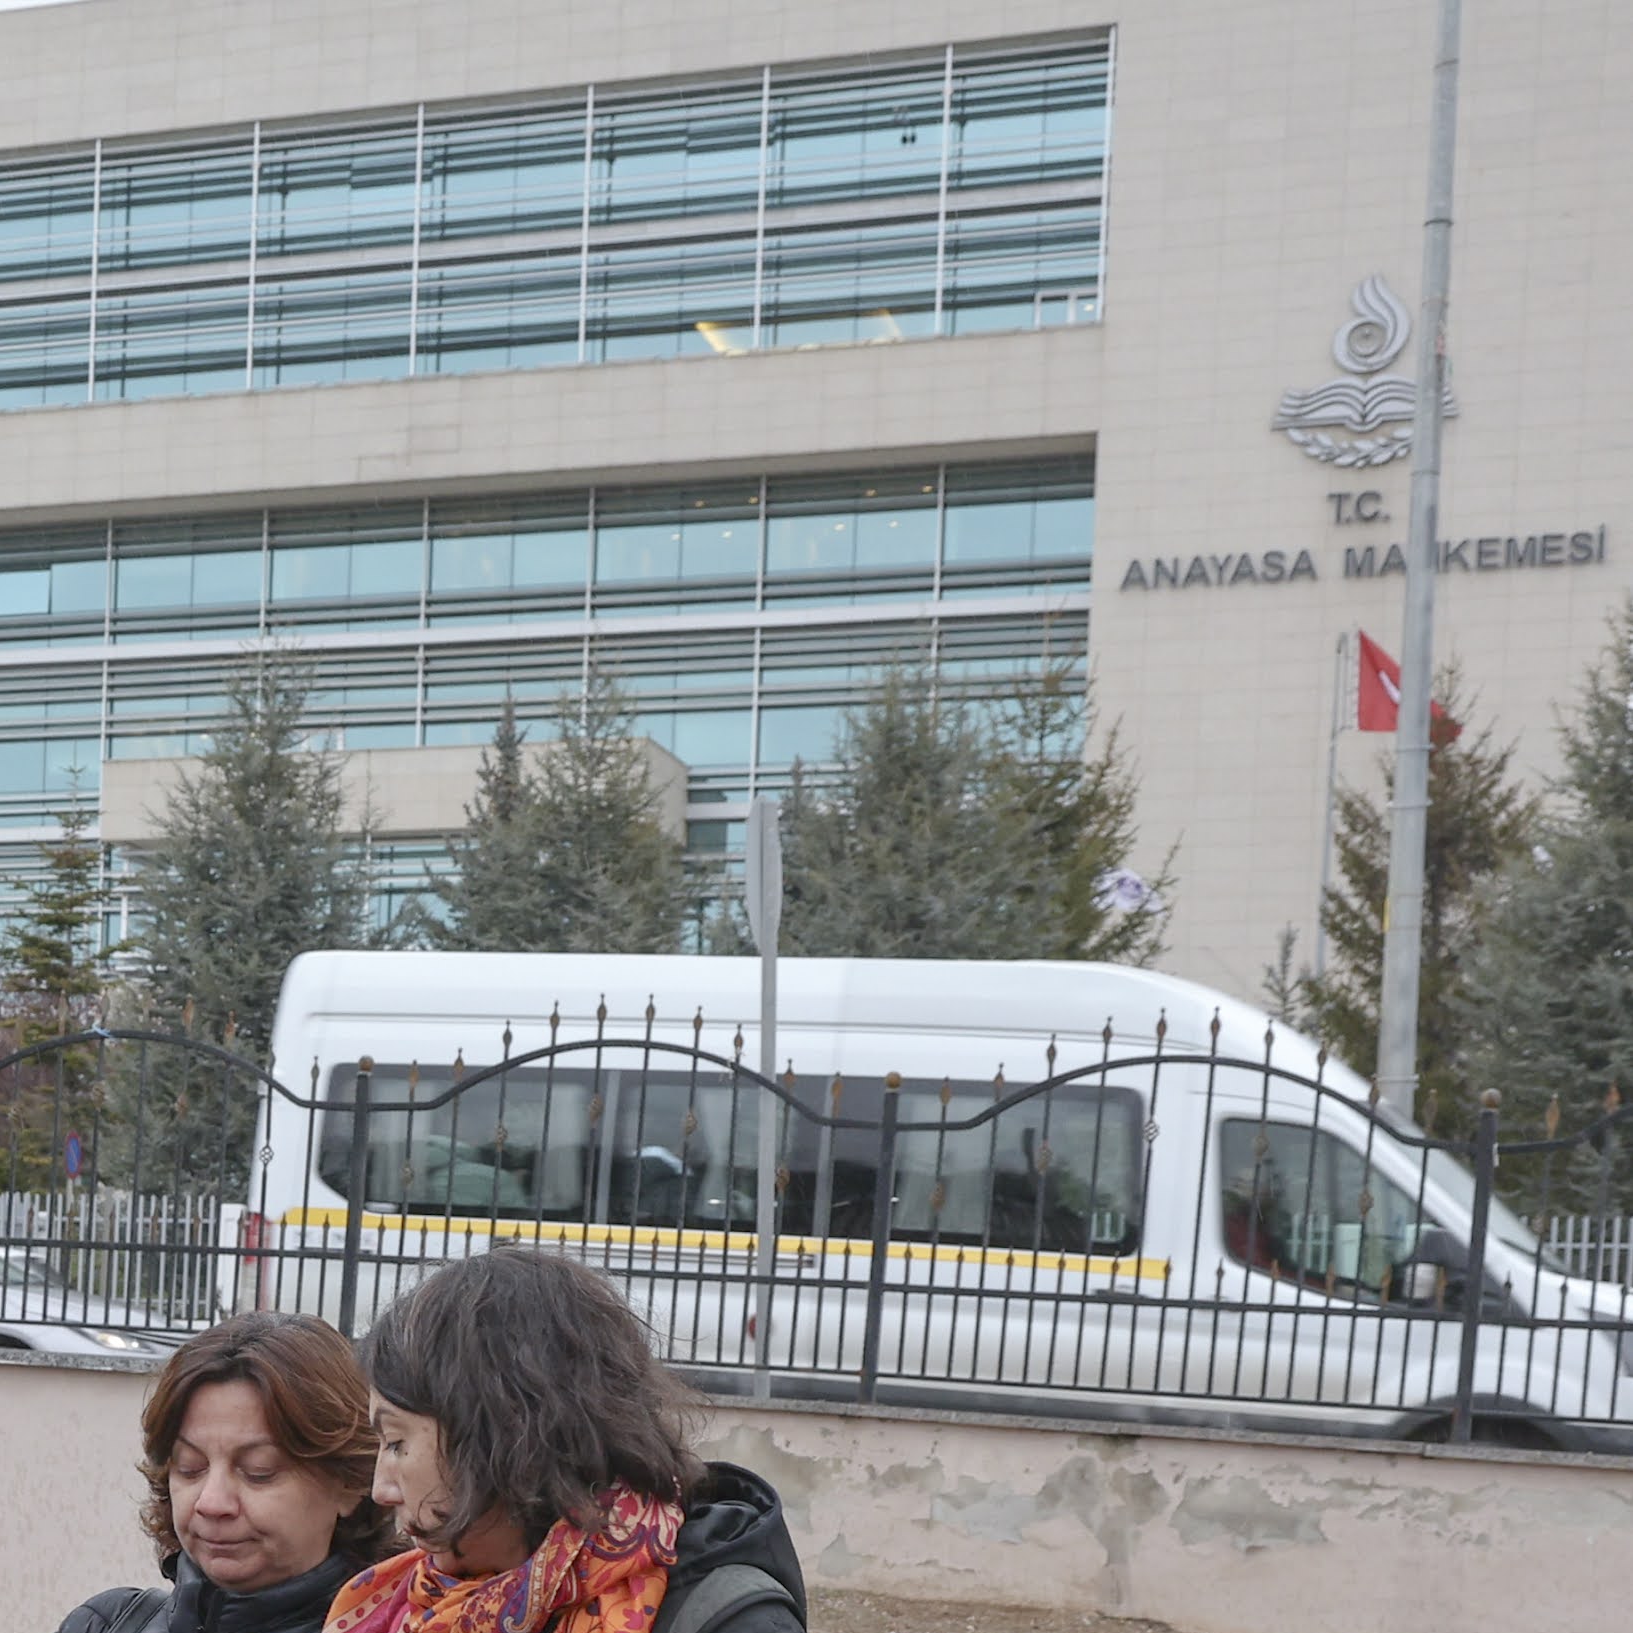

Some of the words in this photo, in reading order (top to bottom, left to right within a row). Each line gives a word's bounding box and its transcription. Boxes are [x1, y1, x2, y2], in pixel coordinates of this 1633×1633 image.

[1326, 491, 1391, 525] T.C.
[1120, 549, 1318, 592] ANAYASA
[1344, 523, 1607, 581] MAKEMESİ
